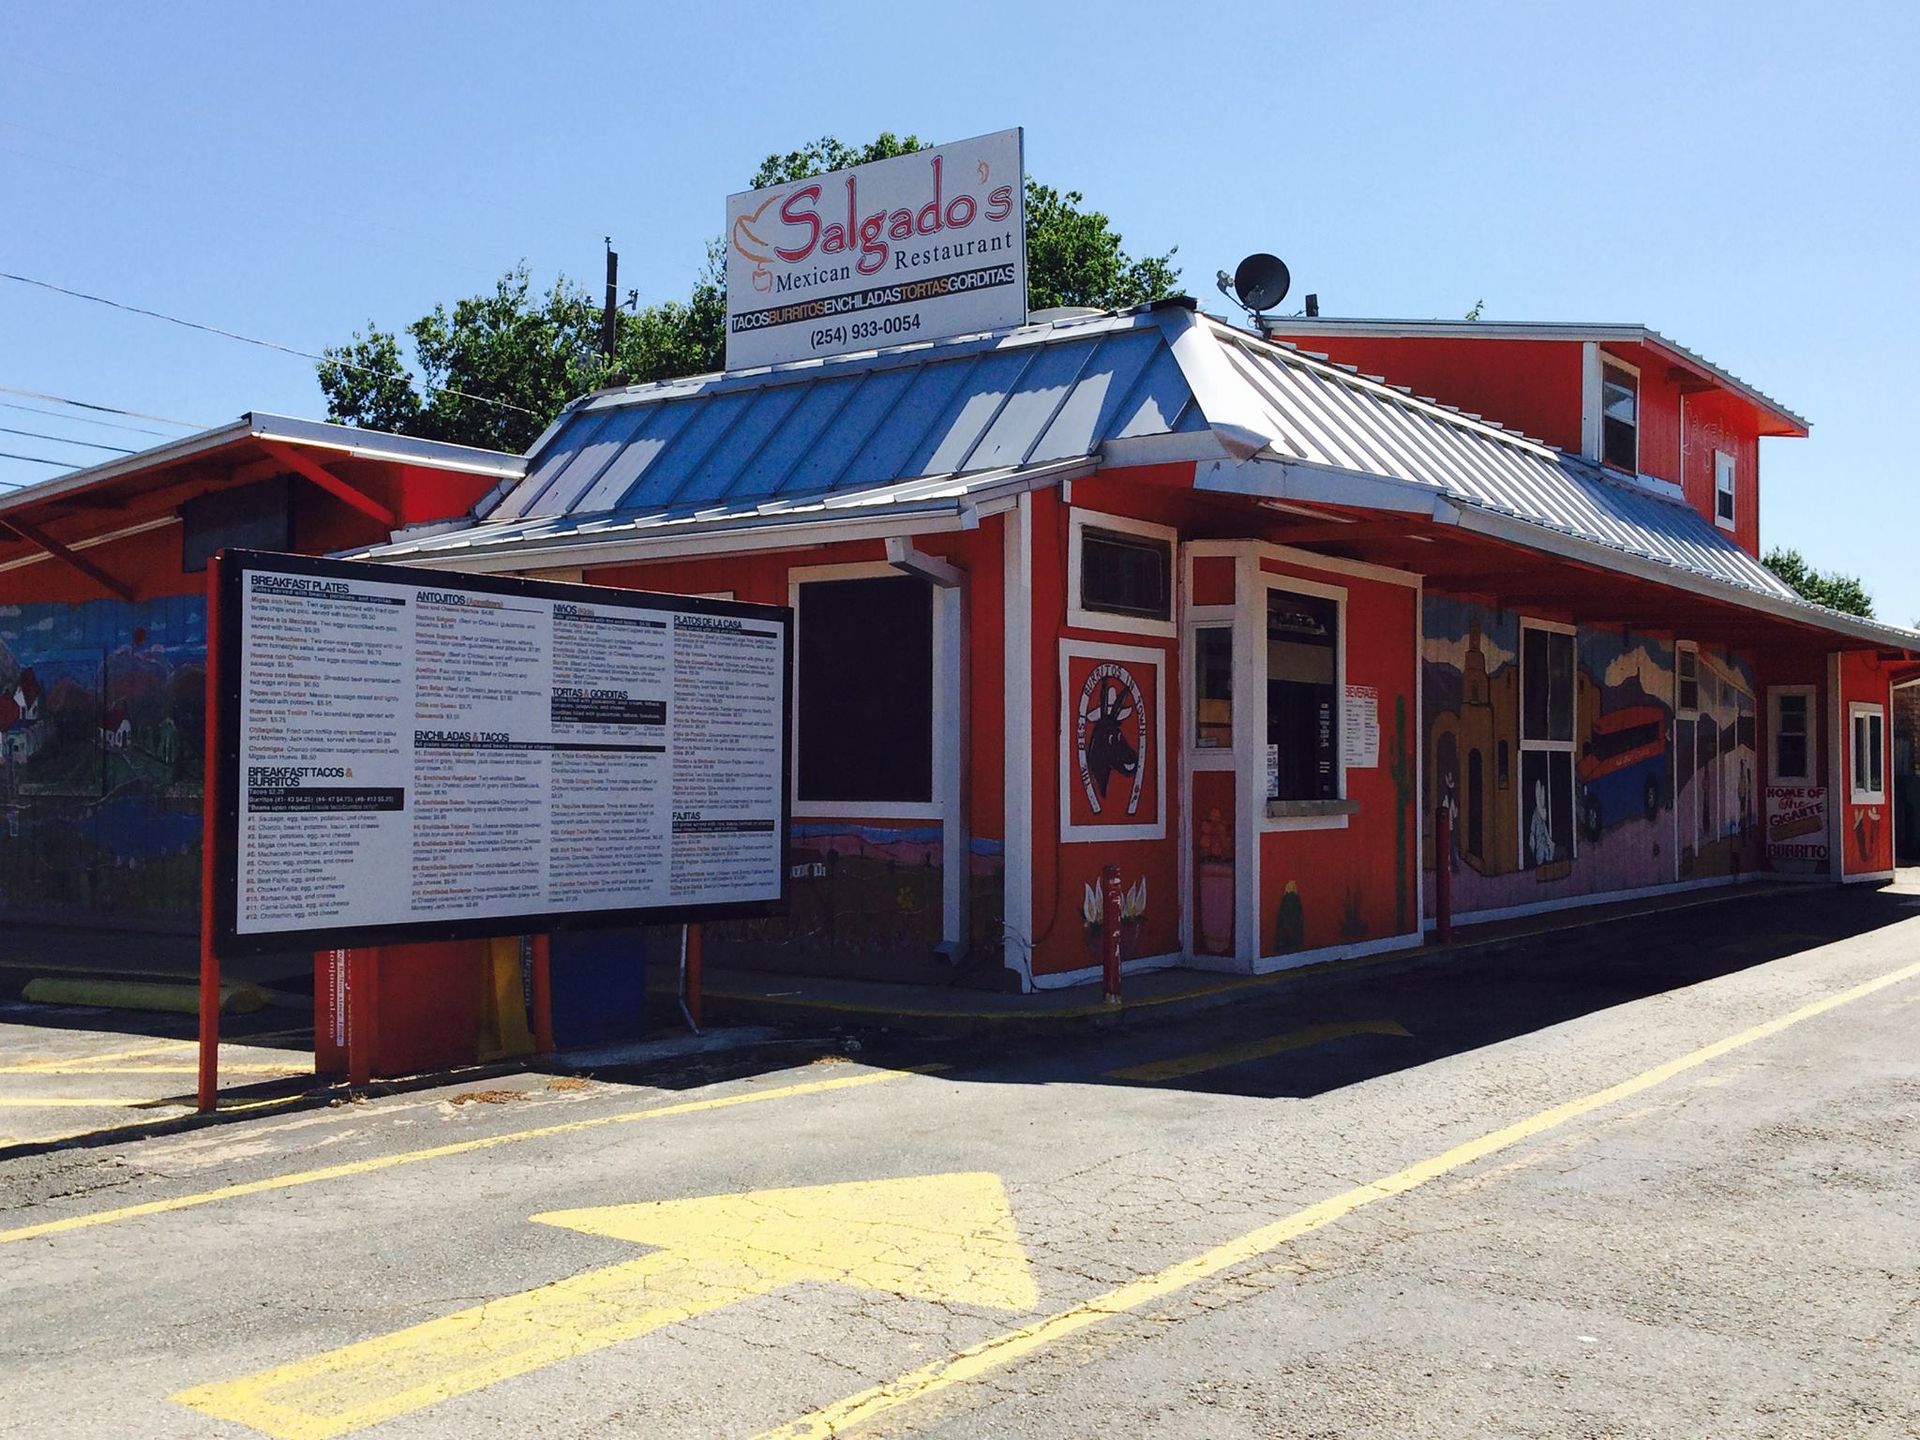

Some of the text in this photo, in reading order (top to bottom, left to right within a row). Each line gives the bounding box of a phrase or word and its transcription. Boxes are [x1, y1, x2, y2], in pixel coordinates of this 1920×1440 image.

[774, 155, 1013, 276] Salgado's
[776, 232, 1013, 293] Mexican Restaurant
[811, 313, 921, 349] (254) 933-0054
[251, 575, 349, 593] BREAKFAST PLATES
[416, 591, 465, 605] ANTOJITOS
[674, 615, 742, 628] PLATOS DE LA CASA
[552, 688, 583, 697] TORTAS
[591, 689, 628, 700] GORDITAS
[1085, 665, 1122, 695] BURRITOS
[1126, 674, 1135, 690] IN
[1137, 696, 1146, 736] TOWN
[415, 730, 509, 742] ENCHILADAS & TACOS
[248, 767, 353, 778] BREAKFAST TACOS &
[248, 777, 299, 786] BURRITOS
[1767, 789, 1824, 798] HOME OF
[673, 812, 701, 820] FAJITAS
[1770, 802, 1824, 826] GIGANTE
[1768, 844, 1827, 858] BURRITO
